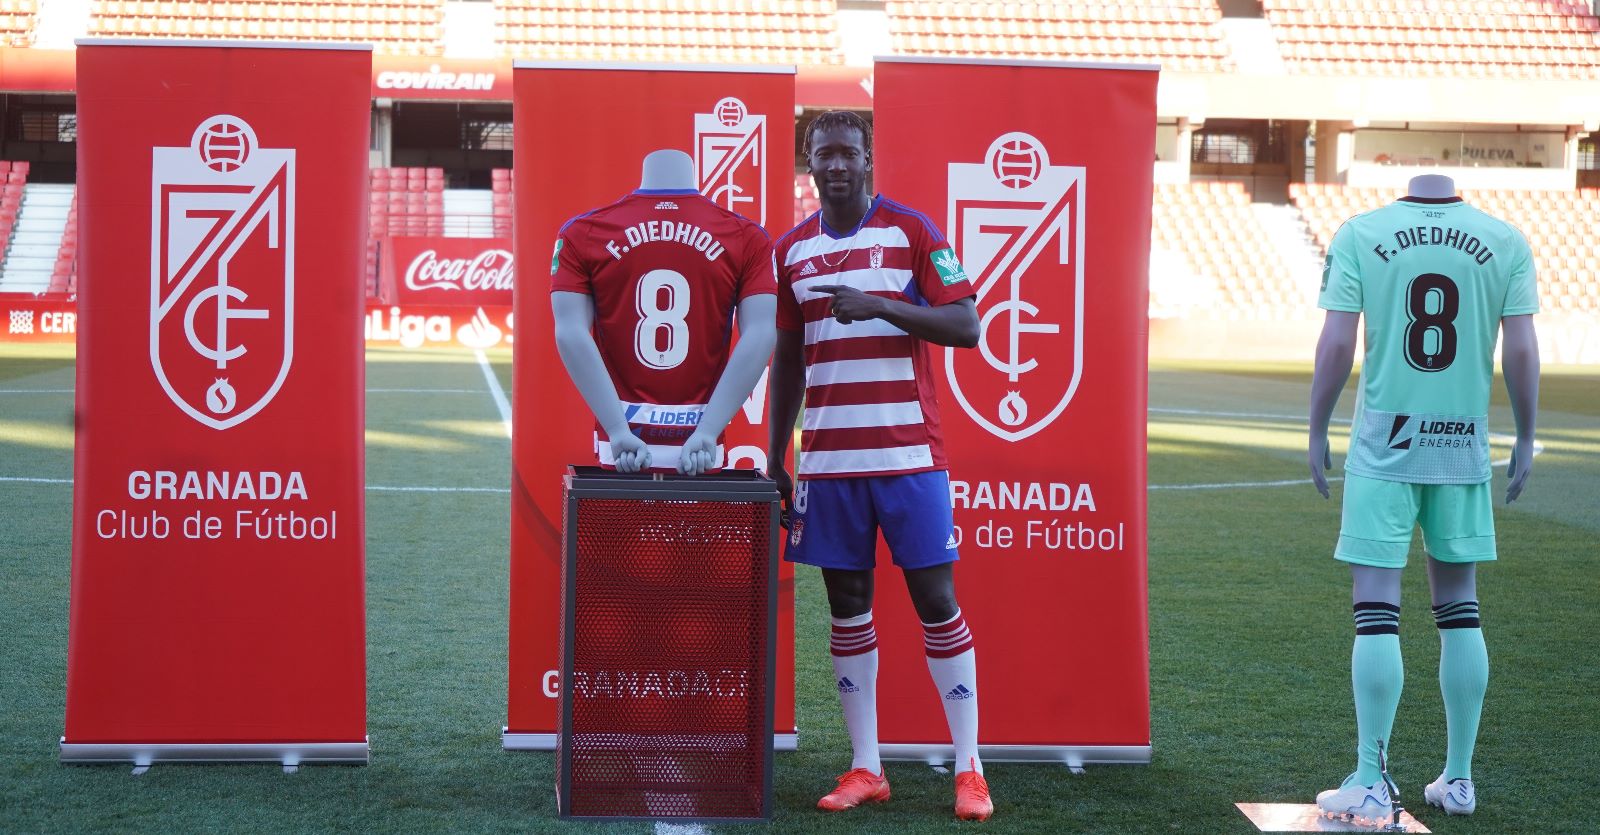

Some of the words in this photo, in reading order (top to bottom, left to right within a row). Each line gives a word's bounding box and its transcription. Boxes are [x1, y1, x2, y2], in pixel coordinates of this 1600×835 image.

[41, 311, 77, 333] CER
[365, 306, 451, 348] Liga
[634, 269, 690, 370] 8
[1403, 273, 1459, 372] 8
[1419, 420, 1475, 435] LIDERA
[1419, 437, 1472, 448] ENERGÍA
[128, 470, 308, 500] GRANADA
[950, 480, 1097, 512] RANADA
[97, 509, 170, 539] Club
[183, 509, 222, 539] de
[235, 508, 337, 540] Fútbol
[975, 519, 1014, 548] de
[1026, 518, 1124, 551] Fútbol
